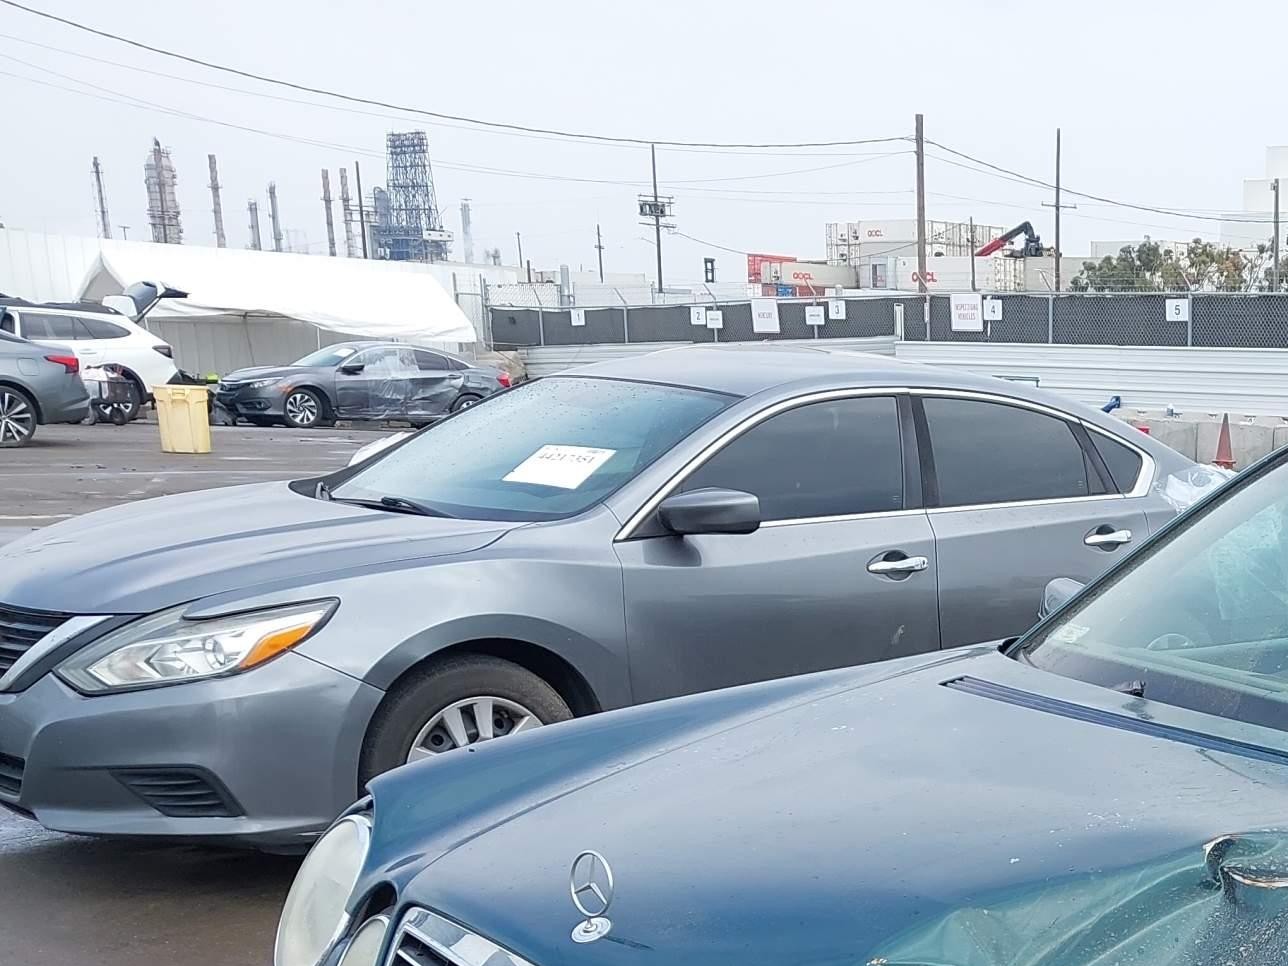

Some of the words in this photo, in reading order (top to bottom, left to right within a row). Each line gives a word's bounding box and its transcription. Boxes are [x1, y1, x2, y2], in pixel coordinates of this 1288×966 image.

[792, 272, 814, 280] OOCL
[911, 271, 938, 283] OCL
[990, 304, 996, 314] 4
[1174, 304, 1181, 316] 5
